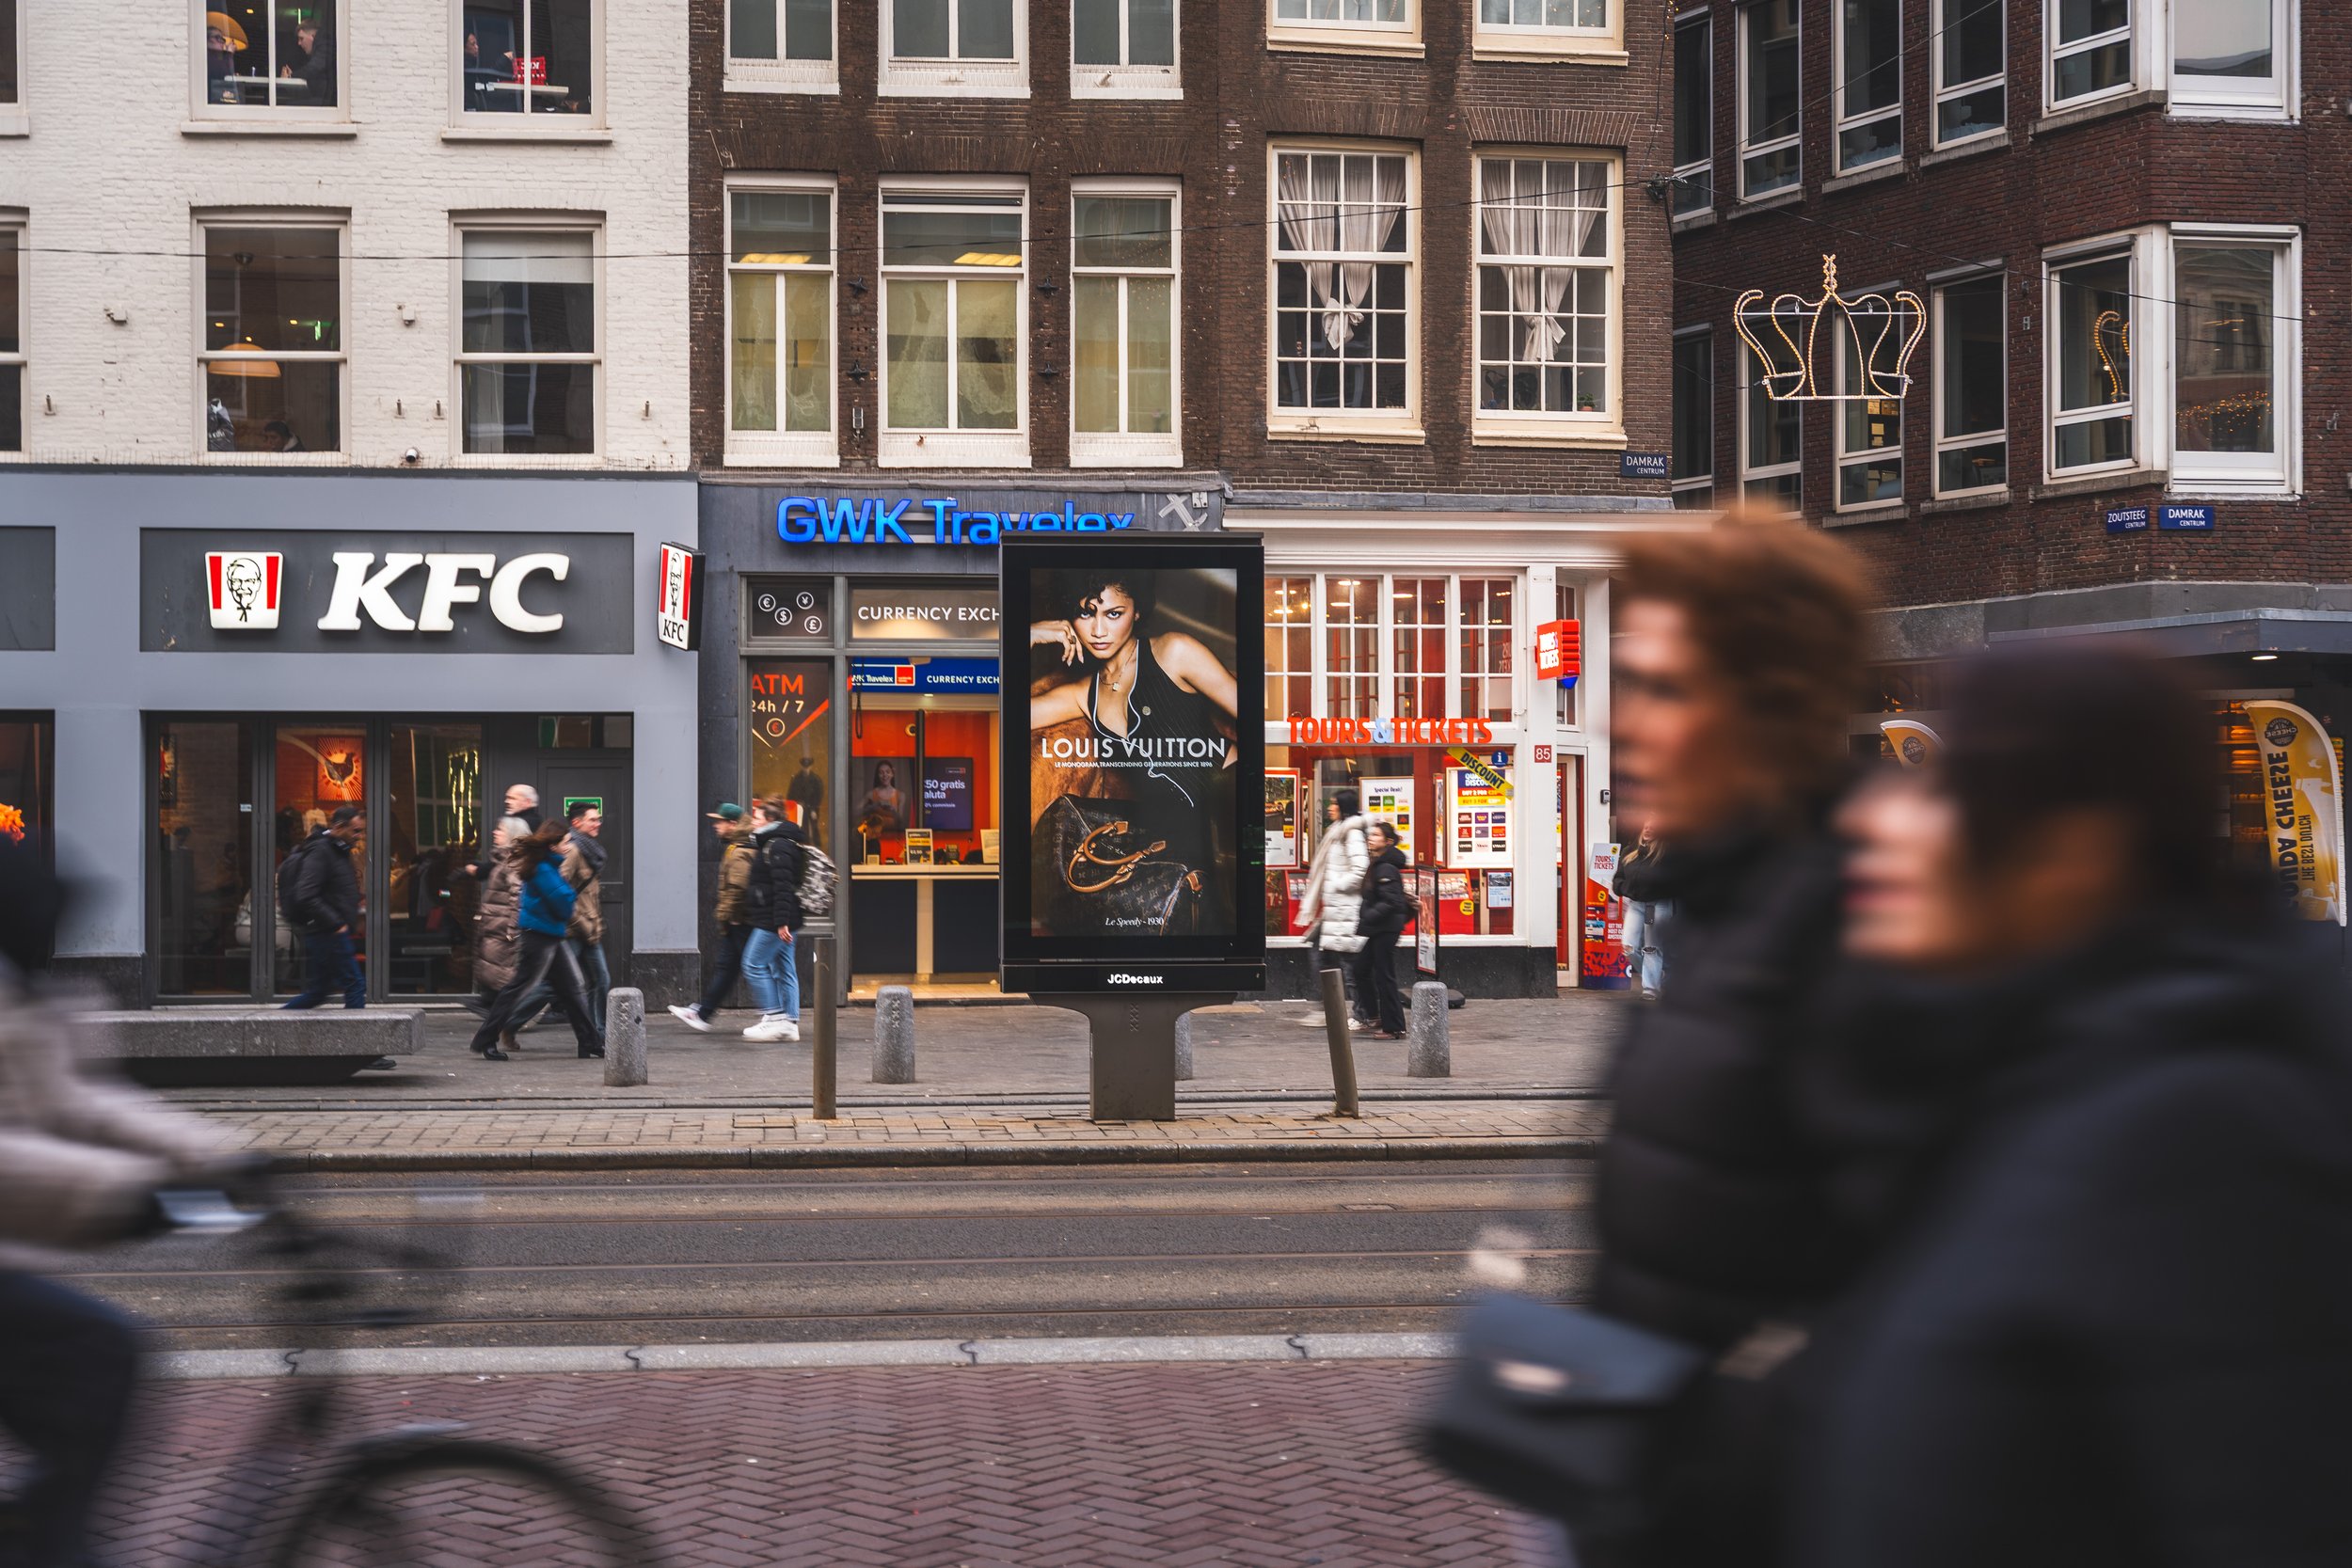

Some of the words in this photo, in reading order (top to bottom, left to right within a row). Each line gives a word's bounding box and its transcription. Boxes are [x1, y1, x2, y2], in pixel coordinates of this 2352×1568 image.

[1626, 456, 1664, 467] DAMRAK
[777, 497, 914, 544] GWK
[2107, 510, 2145, 523] ZOUTSTEEG
[2168, 509, 2205, 519] DAMRAK
[317, 552, 570, 633] KFC
[858, 606, 952, 621] CURRENCY
[663, 619, 683, 642] KFC
[752, 673, 803, 695] ATM
[926, 675, 974, 683] CURRENCY
[977, 675, 1000, 684] EXCH
[795, 700, 804, 713] 7
[1042, 738, 1113, 758] LOUIS
[1120, 738, 1225, 758] VUITTON
[1535, 748, 1551, 760] 85
[1460, 752, 1505, 789] DISCOUNT
[940, 779, 966, 791] gratis
[1105, 917, 1116, 926] Le
[1117, 917, 1142, 927] Speedy
[1147, 917, 1164, 926] 1930
[1107, 974, 1163, 984] JCDecaux
